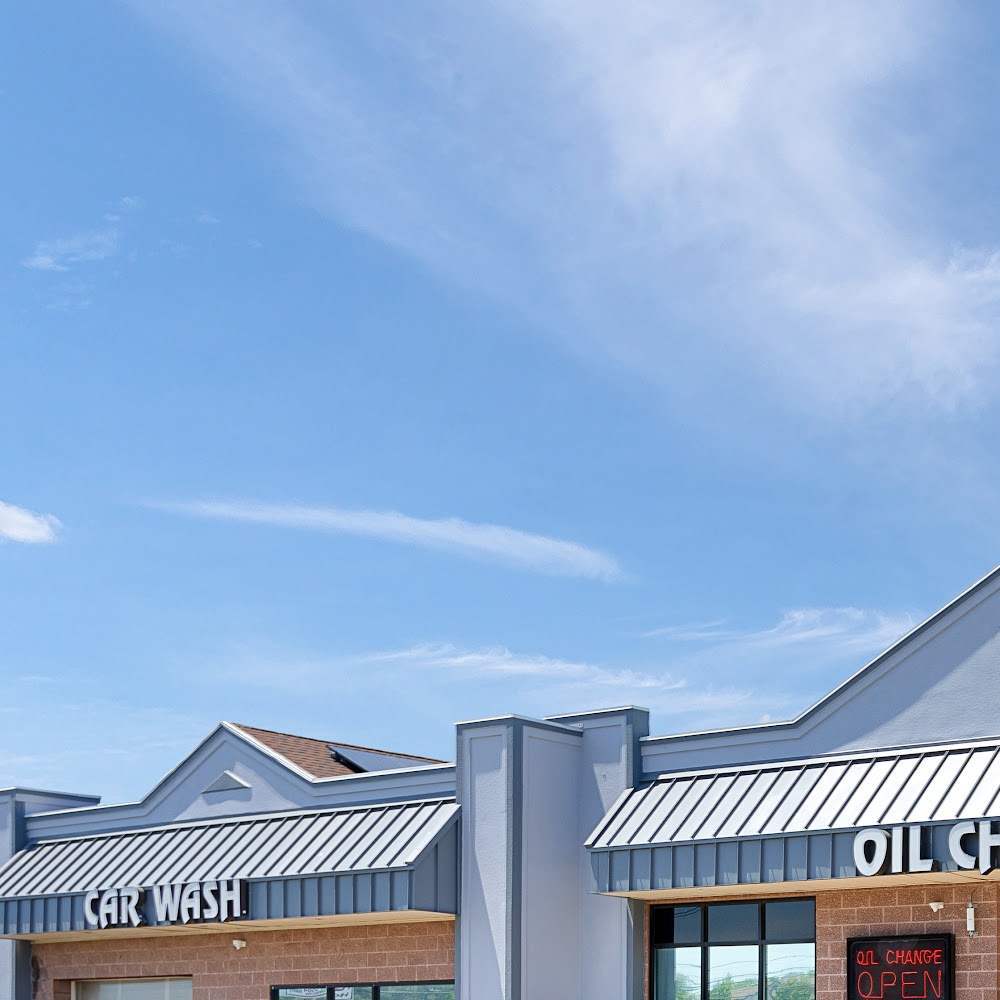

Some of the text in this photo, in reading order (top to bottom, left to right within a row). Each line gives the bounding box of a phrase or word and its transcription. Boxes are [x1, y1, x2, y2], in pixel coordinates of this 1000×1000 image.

[853, 825, 934, 876] OIL
[85, 878, 241, 929] CAR WASH
[857, 949, 942, 966] OIL CHANGE
[857, 970, 942, 999] OPEN
